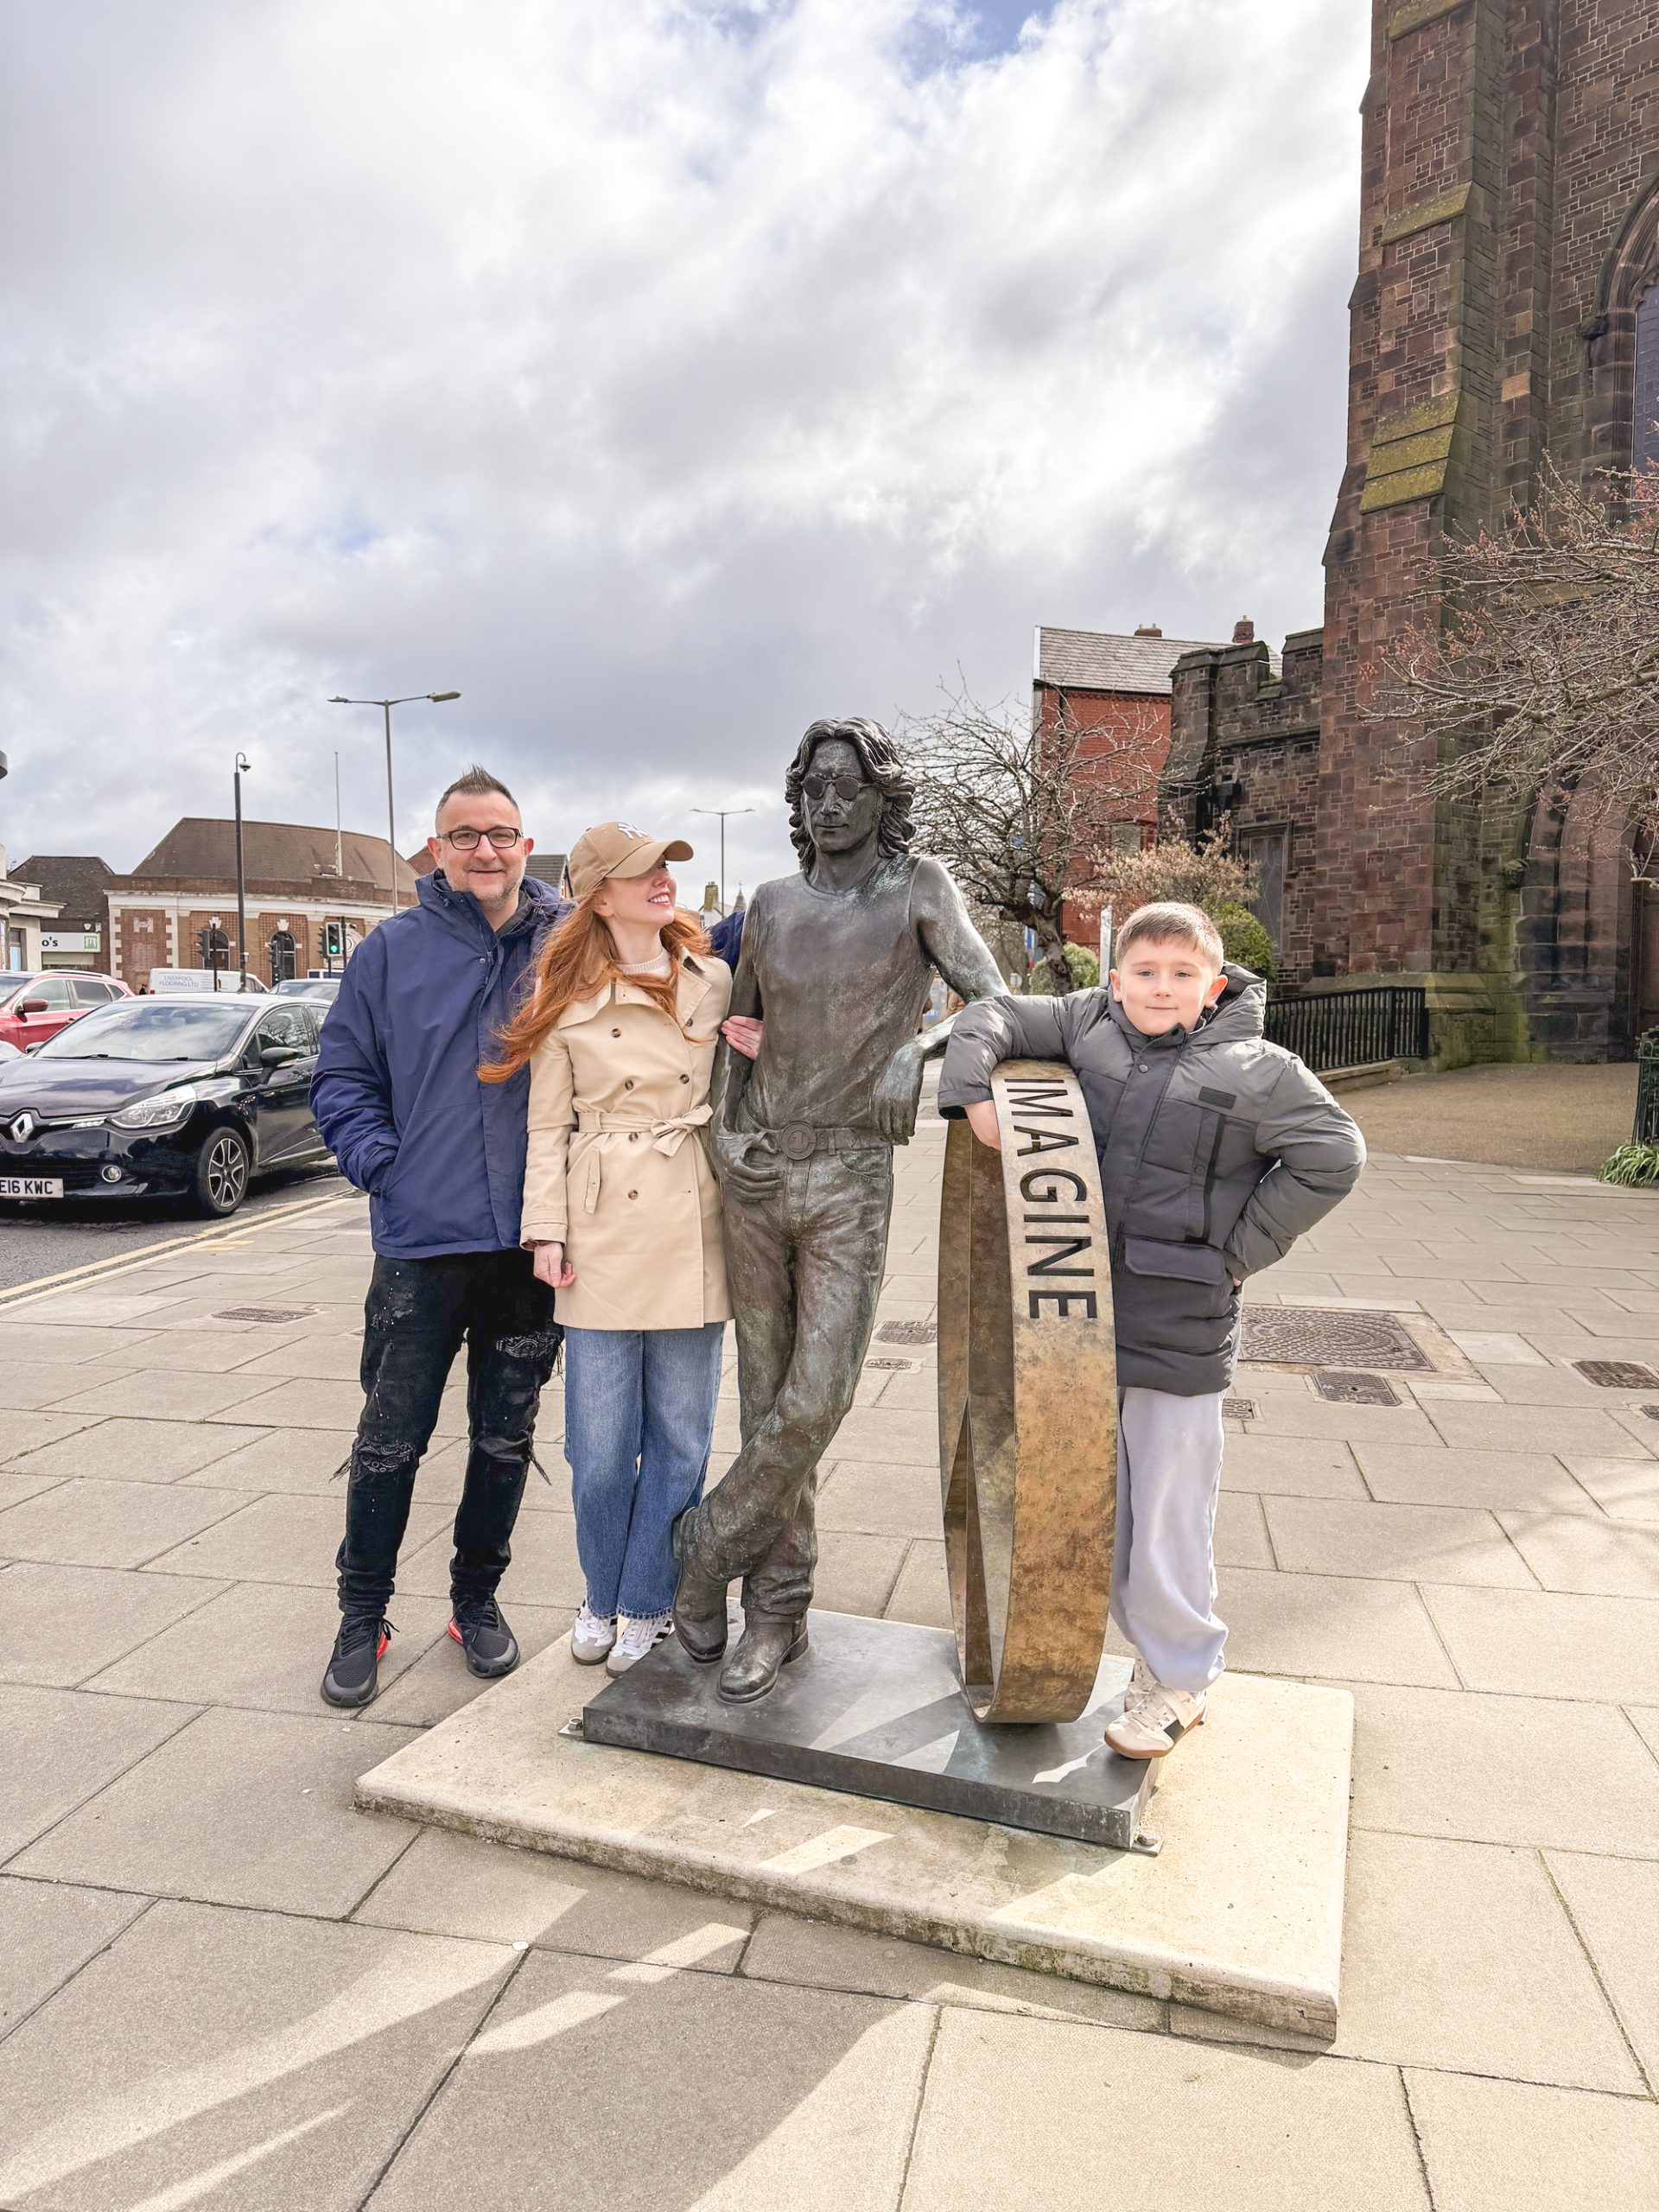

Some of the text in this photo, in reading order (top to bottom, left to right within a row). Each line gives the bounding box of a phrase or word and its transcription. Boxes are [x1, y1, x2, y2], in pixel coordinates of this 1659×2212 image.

[0, 1179, 54, 1194] E16 KWC
[1003, 1078, 1098, 1319] IMAGINE
